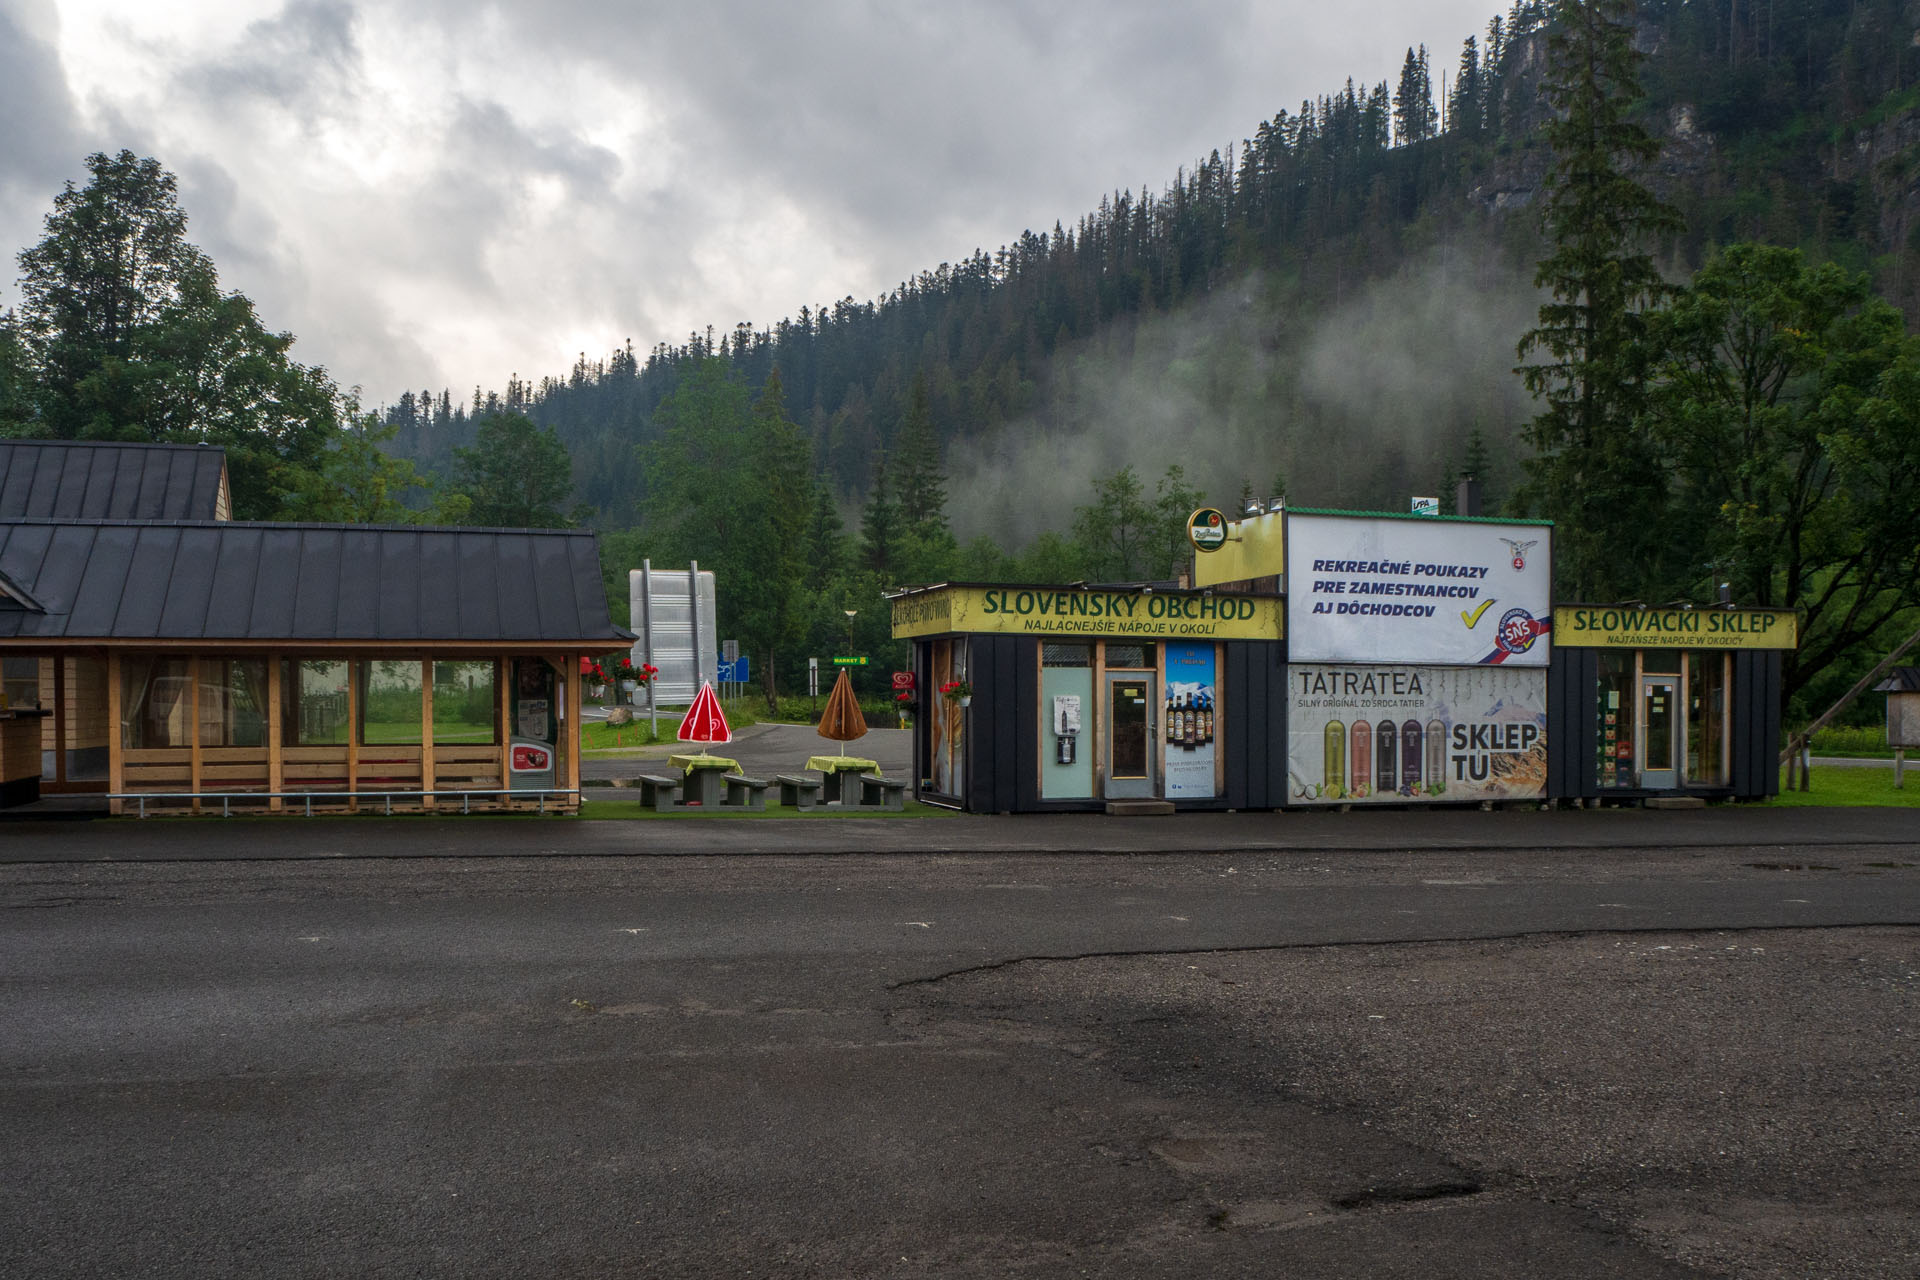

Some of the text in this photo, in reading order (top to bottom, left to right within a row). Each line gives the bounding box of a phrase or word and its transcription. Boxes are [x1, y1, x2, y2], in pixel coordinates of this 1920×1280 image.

[1312, 559, 1489, 579] REKREAČNÉ POUKAZY
[1312, 580, 1480, 599] PRE ZAMESTNANCOV
[1147, 594, 1256, 621] OBCHOD
[1312, 600, 1436, 618] AJ DÔCHODCOV
[1024, 619, 1216, 635] NAJLACNEJŠIE NÁPOJE V OKOLÍ
[1505, 621, 1531, 641] SNS
[1573, 610, 1776, 633] SŁOWACKI SKLEP
[1696, 637, 1706, 645] W
[1298, 671, 1423, 695] TATRATEA
[1361, 700, 1371, 708] ZO
[1373, 700, 1398, 708] SRDCA
[1400, 700, 1425, 708] TATIER
[1452, 723, 1538, 750] SKLEP
[1452, 755, 1488, 781] TU
